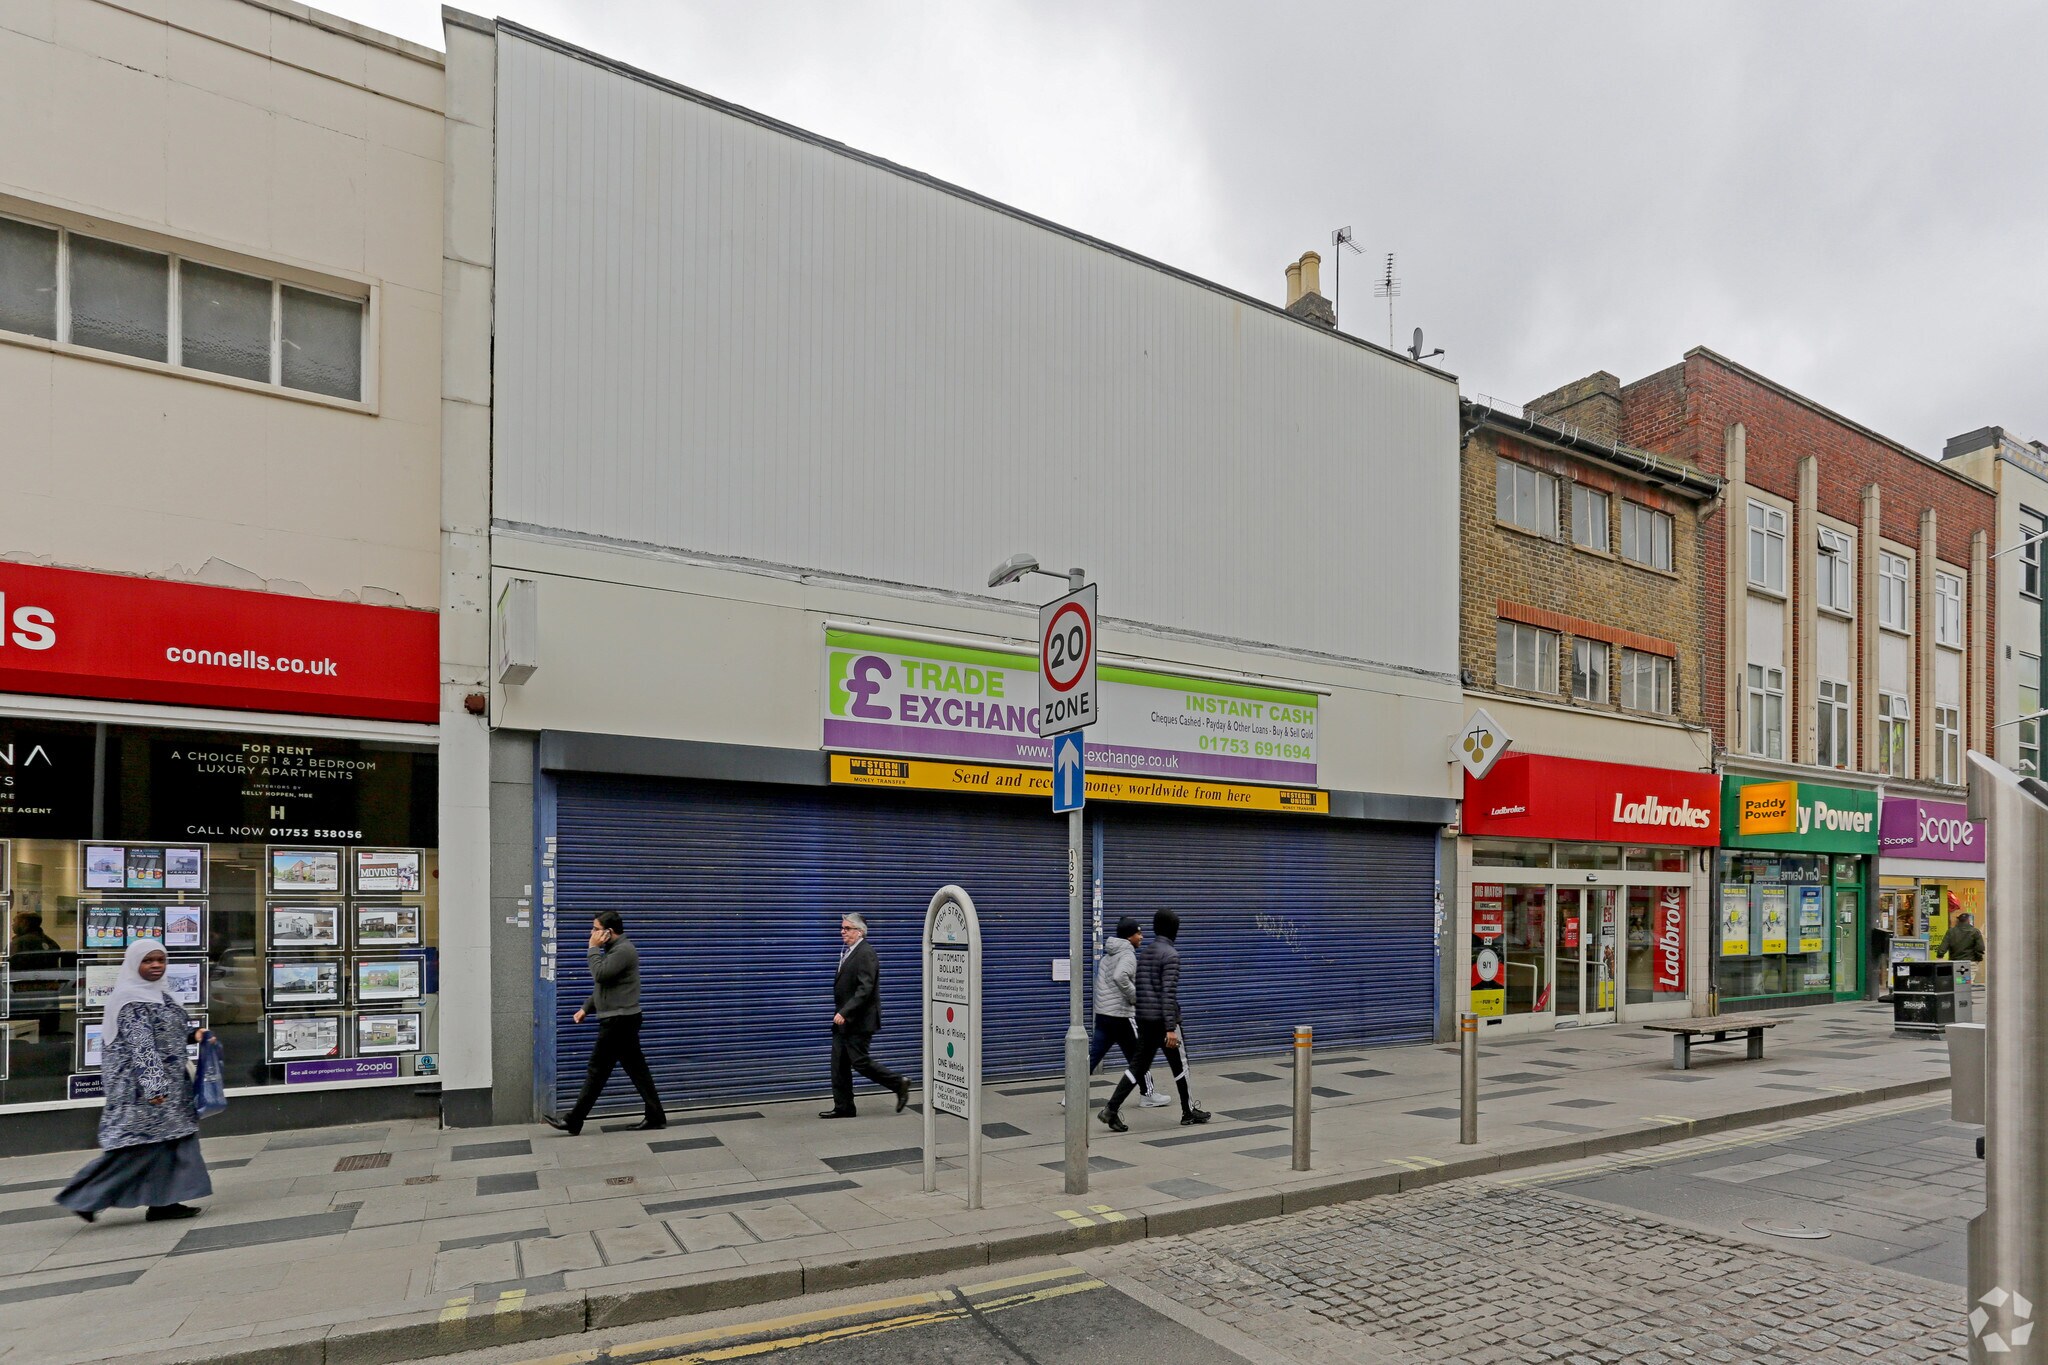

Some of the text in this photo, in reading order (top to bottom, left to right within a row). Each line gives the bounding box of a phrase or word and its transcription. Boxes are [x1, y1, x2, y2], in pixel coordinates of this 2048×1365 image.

[1050, 626, 1083, 669] 20
[166, 646, 338, 677] connells.co.uk
[901, 660, 1004, 698] TRADE
[900, 693, 1040, 734] EXCHANG
[1045, 692, 1089, 724] ZONE
[1186, 695, 1314, 725] INSTANT CASH
[1151, 711, 1178, 726] Cheques
[1179, 714, 1201, 728] Cashed
[1206, 719, 1226, 732] Payday
[1227, 721, 1233, 730] &
[1233, 722, 1251, 732] Other
[1252, 723, 1269, 734] Loans
[1272, 725, 1283, 737] Buy
[1284, 726, 1290, 736] &
[1290, 727, 1300, 738] Sell
[1301, 728, 1313, 740] Gold
[242, 744, 313, 756] FOR RENT
[1199, 735, 1311, 760] 01753 691694
[171, 751, 376, 771] A CHOICE OF 1 & 2 BEDROOM
[851, 760, 898, 769] WESTERN
[198, 764, 353, 780] LUXURY APARTMENTS
[867, 768, 898, 777] UNION
[952, 769, 988, 785] Send
[995, 773, 1021, 788] and
[265, 791, 296, 799] HOPPEN,
[1129, 783, 1189, 799] worldwide
[1194, 787, 1222, 801] from
[1227, 790, 1251, 803] here
[1491, 805, 1525, 816] Ladbrokes
[1613, 793, 1711, 829] Ladbrokes
[1745, 798, 1786, 811] Paddy
[1745, 809, 1786, 820] Power
[1814, 800, 1873, 833] Power
[187, 826, 362, 839] CALL NOW 01753 538056
[1919, 808, 1974, 852] Scope
[1884, 837, 1914, 846] Scope
[1474, 886, 1502, 898] BIG MATCH
[935, 906, 966, 932] HIGH STREET
[1659, 887, 1680, 987] Ladbroke
[937, 953, 965, 963] AUTOMATIC
[1482, 960, 1492, 969] 9/1
[939, 964, 962, 974] BOLLARD
[1904, 1001, 1926, 1010] Slough
[952, 1028, 966, 1041] Rising
[356, 1062, 393, 1072] Zoopla
[938, 1058, 964, 1073] ONE Vehicle
[938, 1070, 965, 1084] may proceed
[937, 1092, 965, 1106] CHECK BOLLARD
[955, 1090, 968, 1099] SHOWS
[941, 1099, 961, 1113] IS LOWERED
